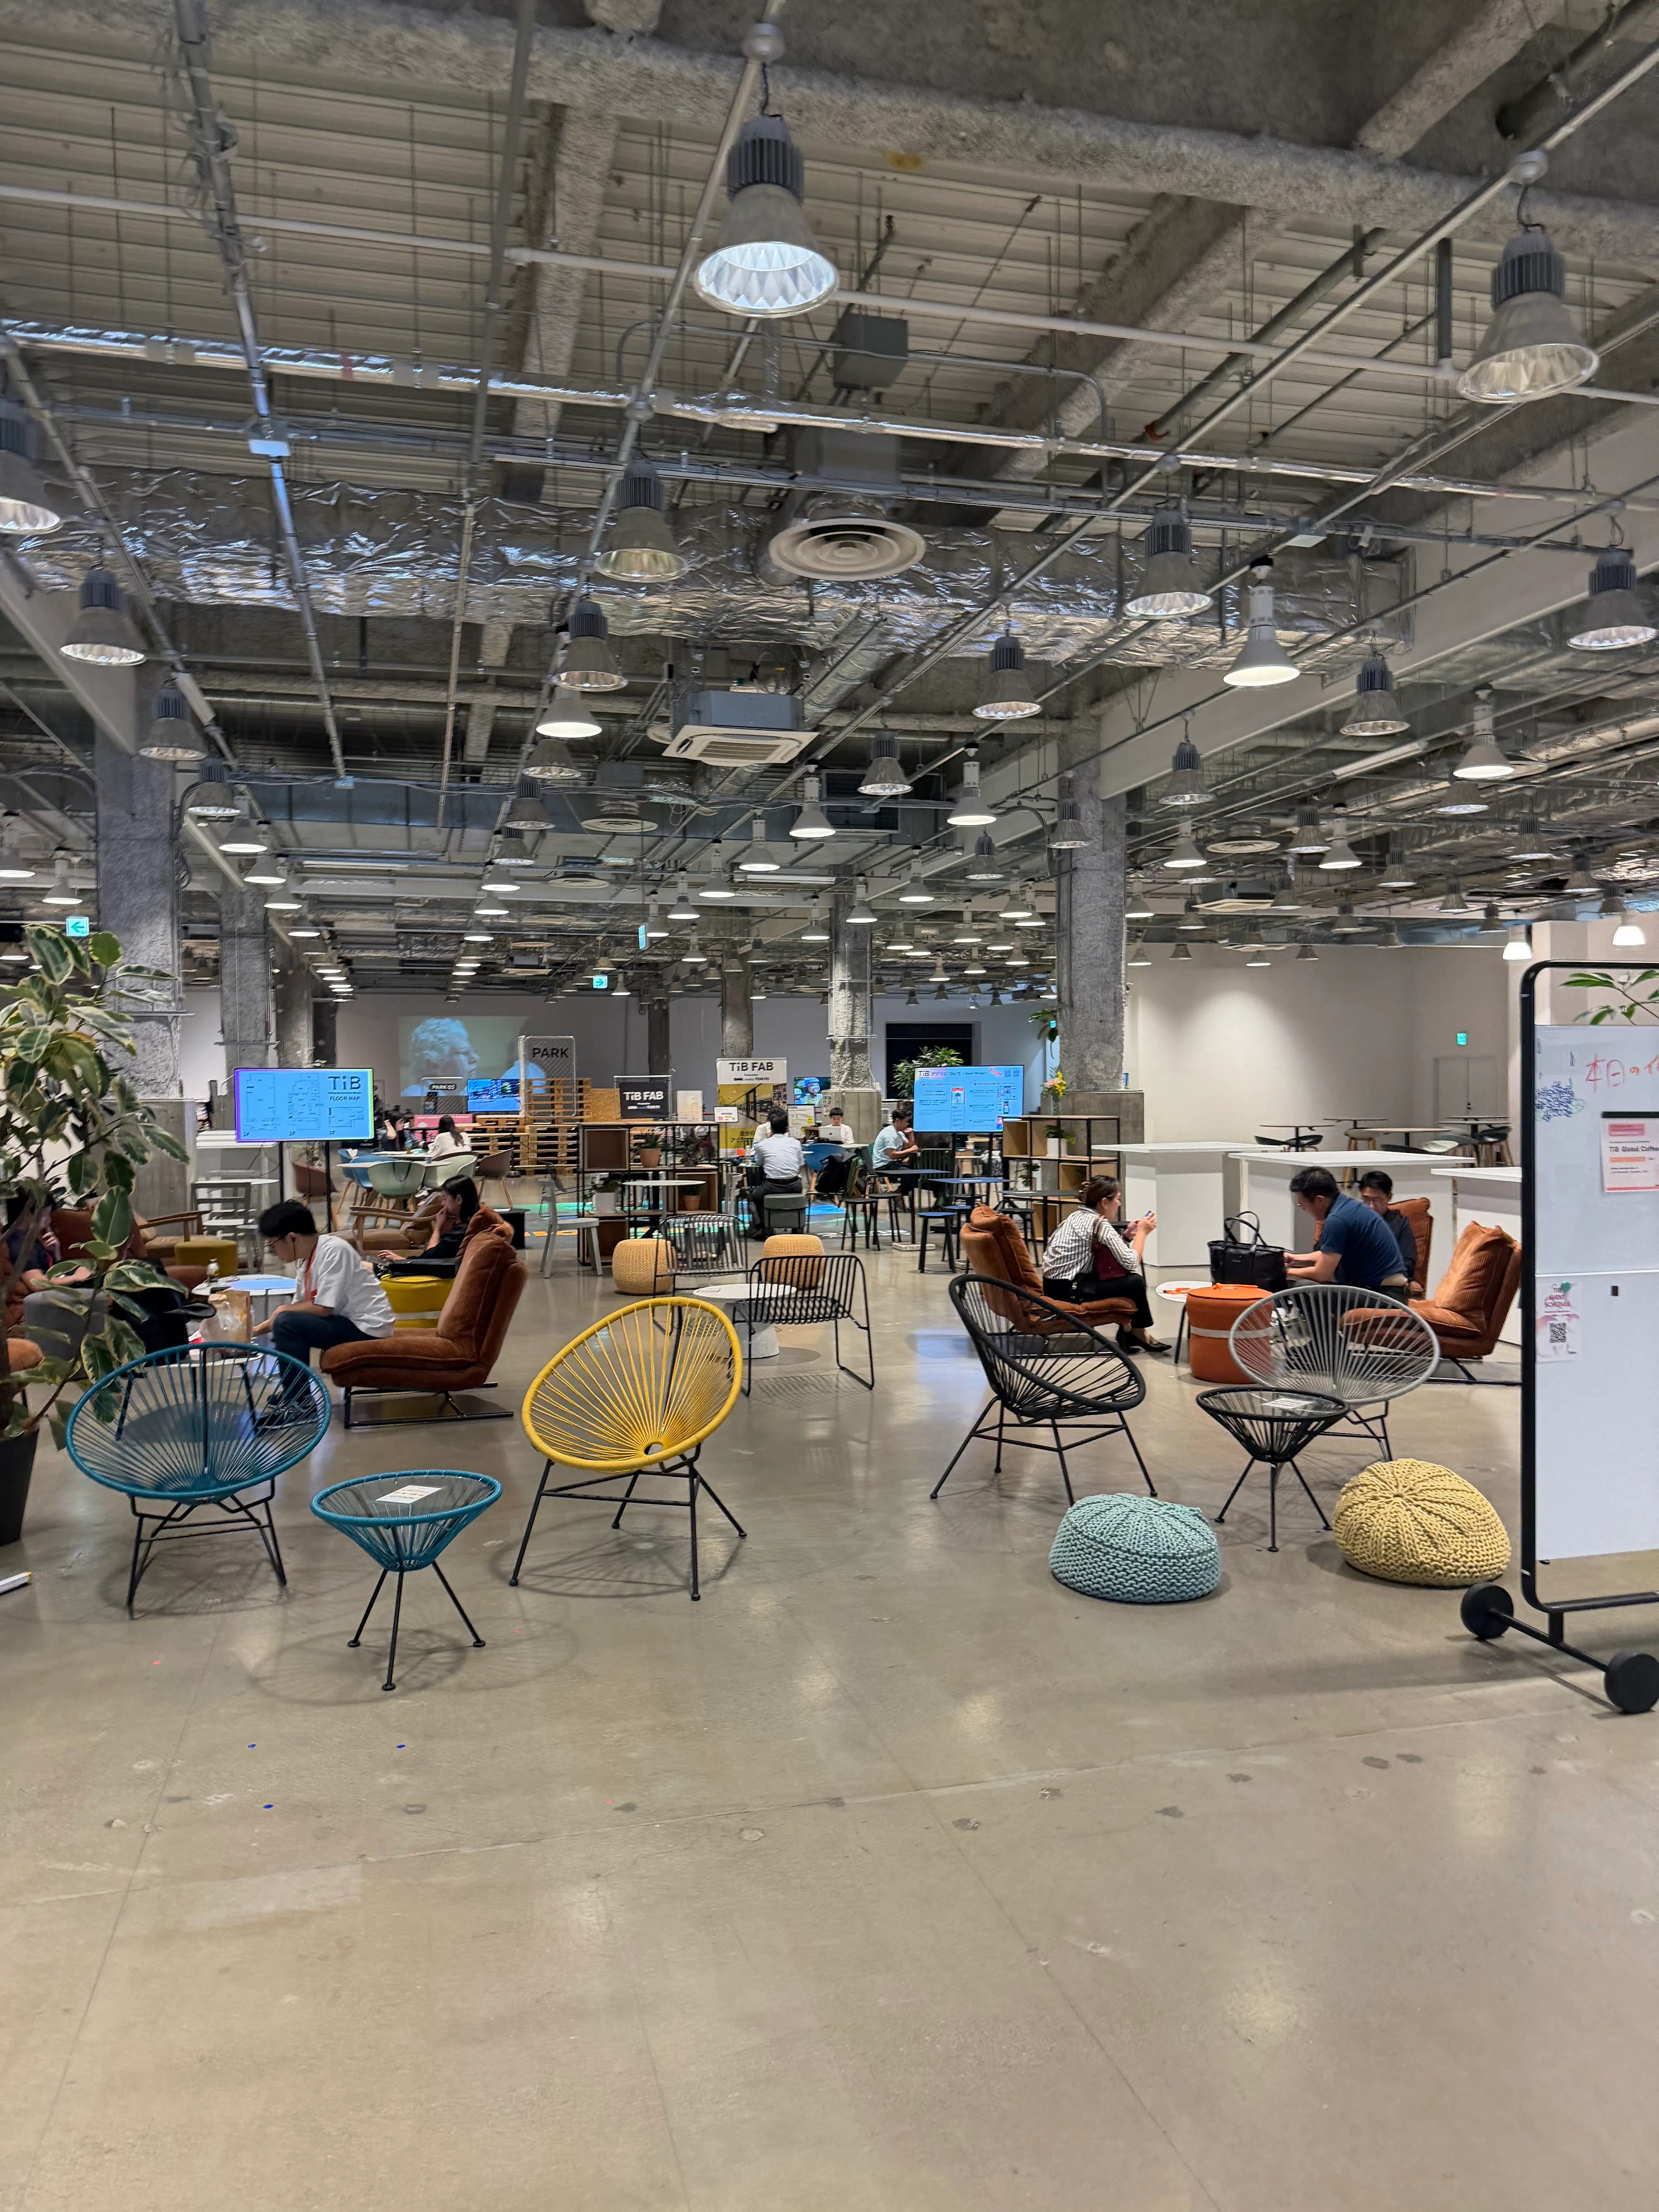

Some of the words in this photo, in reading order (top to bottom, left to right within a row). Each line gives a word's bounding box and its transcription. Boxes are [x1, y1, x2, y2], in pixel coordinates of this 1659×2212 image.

[532, 1048, 569, 1058] PARK
[728, 1062, 749, 1072] TiB
[751, 1062, 774, 1071] FAB
[327, 1075, 361, 1090] TiB
[622, 1091, 642, 1101] TiB
[642, 1091, 664, 1100] FAB
